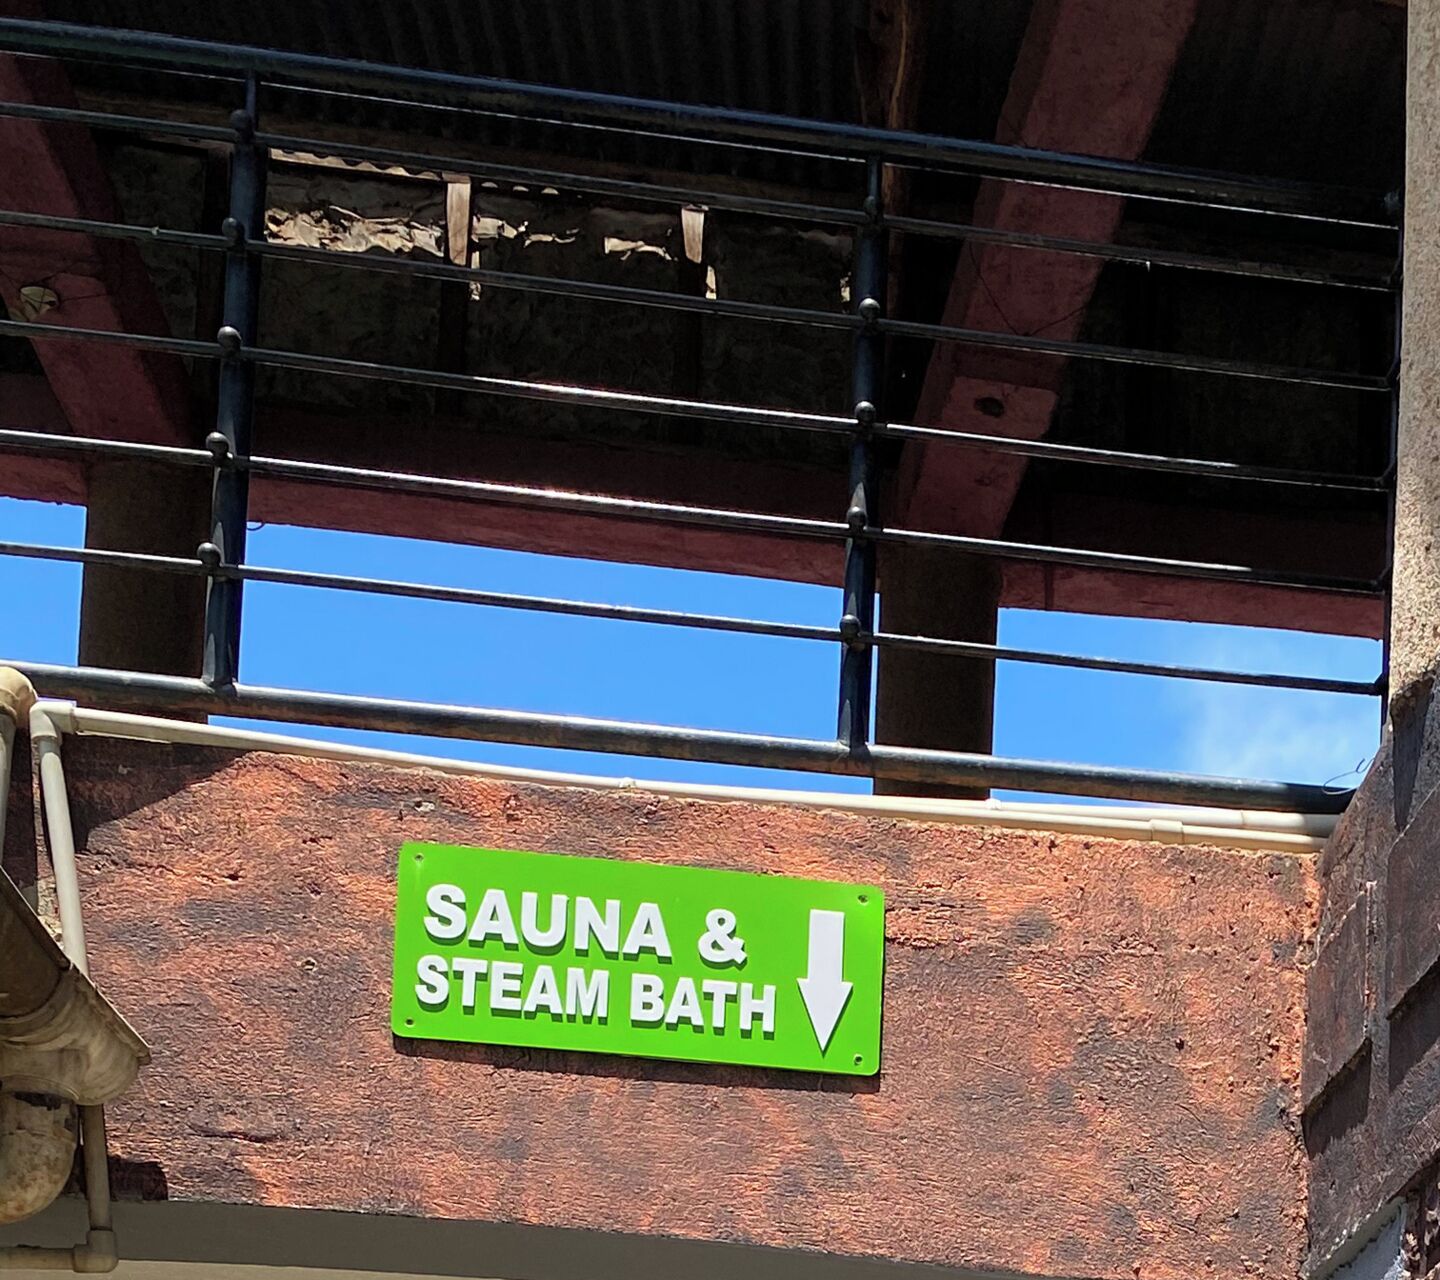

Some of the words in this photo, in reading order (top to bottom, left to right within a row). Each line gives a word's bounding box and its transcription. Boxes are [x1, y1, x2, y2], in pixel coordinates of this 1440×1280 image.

[423, 884, 672, 962] SAUNA
[698, 908, 748, 970] &
[415, 955, 610, 1023] STEAM
[630, 973, 777, 1039] BATH
